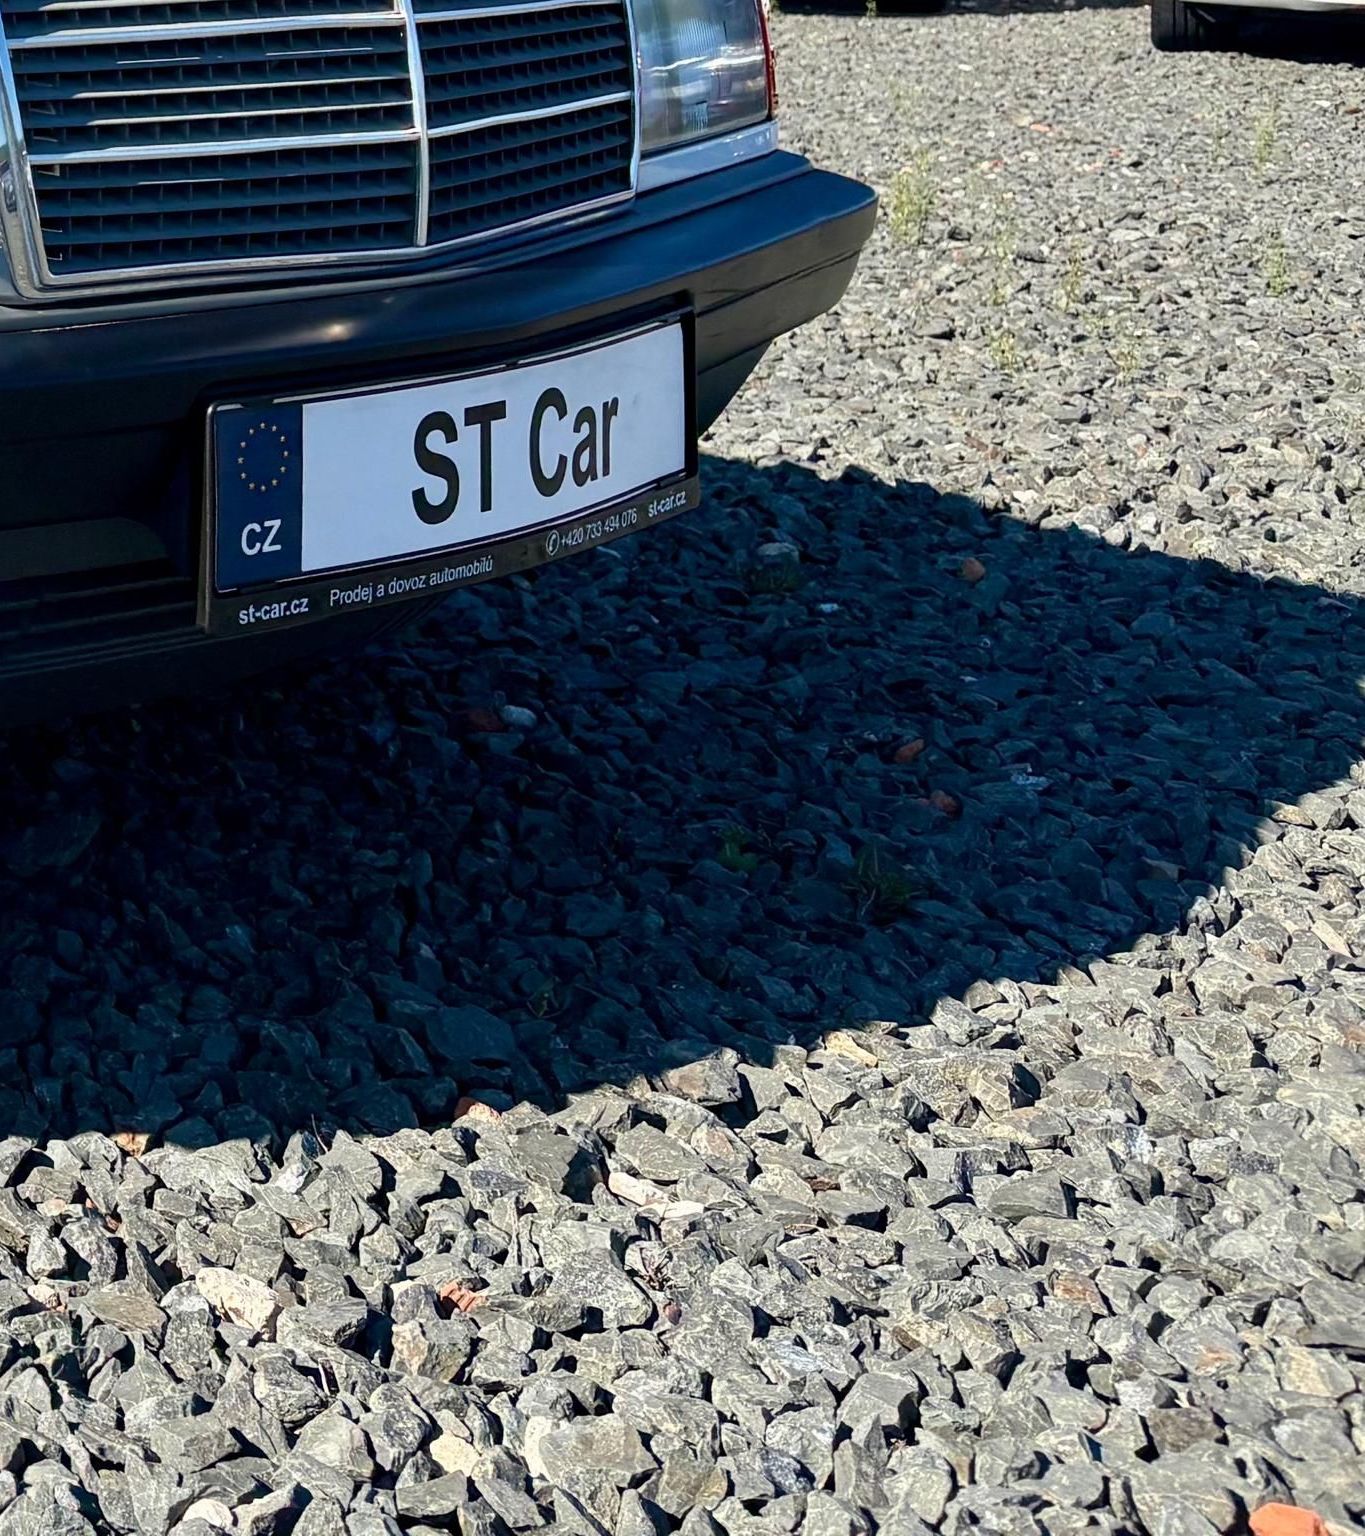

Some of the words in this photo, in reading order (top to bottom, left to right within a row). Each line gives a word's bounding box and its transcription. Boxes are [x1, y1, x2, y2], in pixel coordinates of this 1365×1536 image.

[411, 399, 507, 526] ST
[529, 386, 620, 498] Car
[238, 596, 310, 626] st-car.cz
[329, 583, 374, 607] Prodej
[375, 582, 385, 597] a
[387, 574, 427, 596] dovoz
[561, 526, 585, 547] +420
[647, 490, 688, 519] st-car.cz
[240, 518, 283, 556] CZ
